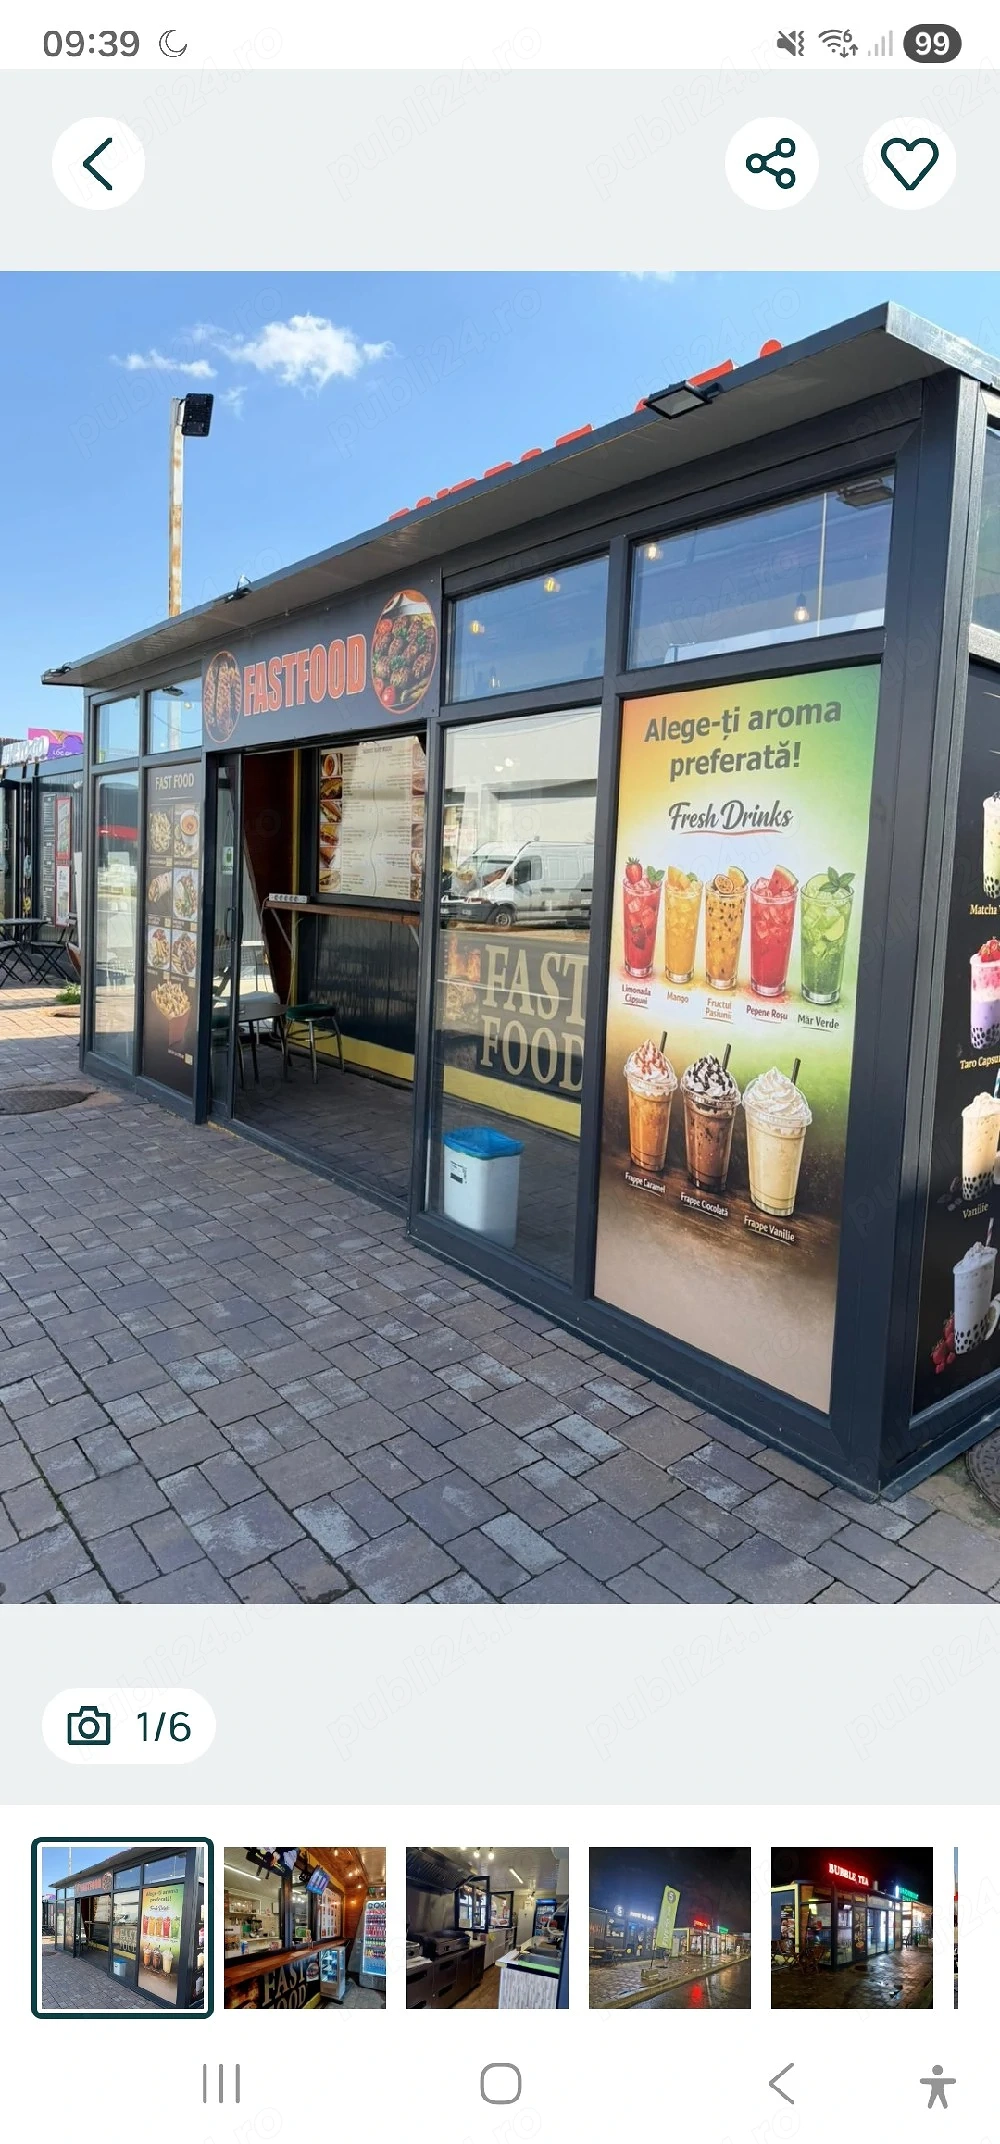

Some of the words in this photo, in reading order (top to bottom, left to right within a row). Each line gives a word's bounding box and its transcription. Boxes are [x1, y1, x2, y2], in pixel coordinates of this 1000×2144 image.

[42, 30, 140, 58] 09:39
[915, 31, 951, 56] 99
[243, 633, 367, 717] FASTFOOD
[747, 700, 842, 731] aroma
[669, 741, 801, 782] preferată!
[155, 775, 172, 791] FAST
[173, 772, 195, 789] FOOD
[668, 802, 719, 831] Fresh
[719, 799, 793, 831] Drinks
[969, 904, 997, 915] Matcha
[482, 944, 589, 1027] FAST
[666, 990, 690, 1004] Mango
[746, 1004, 770, 1017] Pepene
[815, 1016, 840, 1029] Verde
[480, 1015, 584, 1092] FOOD
[959, 1059, 977, 1070] Taro
[962, 1202, 989, 1219] Vanilie
[743, 1215, 769, 1233] Frappe
[768, 1225, 795, 1242] Vanilie
[136, 1711, 192, 1742] 1/6
[828, 1863, 856, 1882] BUBBLE
[857, 1875, 869, 1887] TEA
